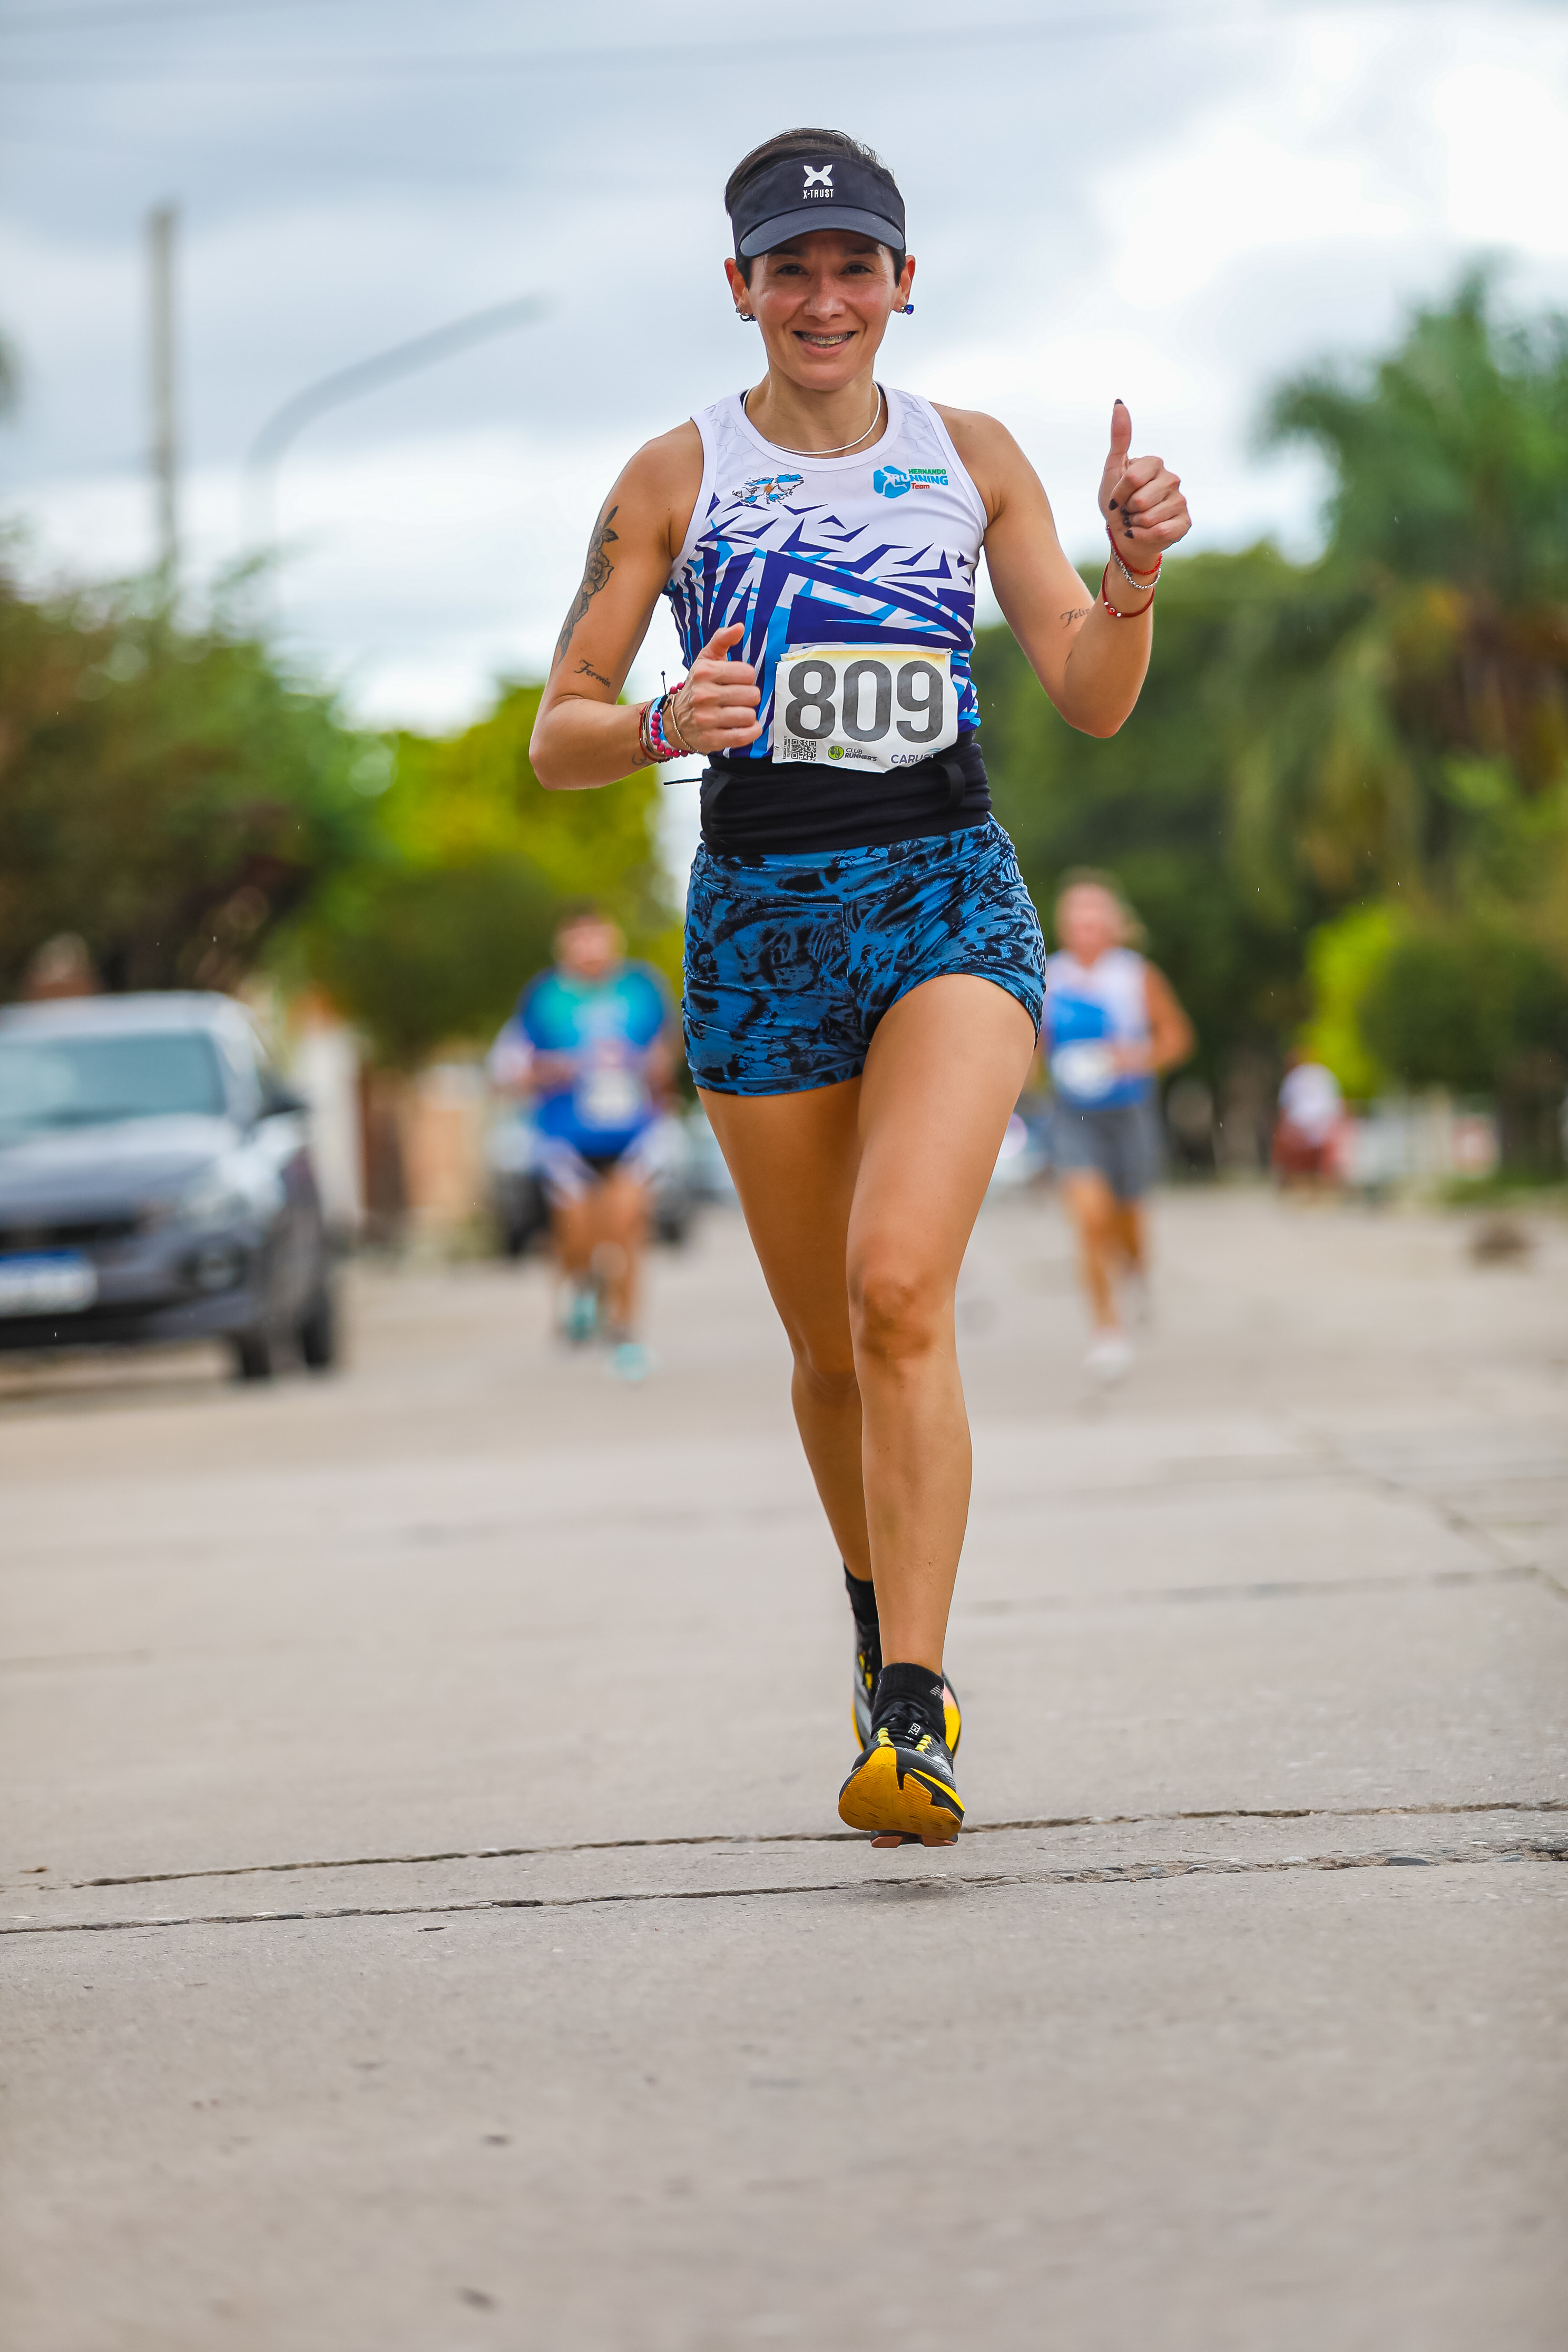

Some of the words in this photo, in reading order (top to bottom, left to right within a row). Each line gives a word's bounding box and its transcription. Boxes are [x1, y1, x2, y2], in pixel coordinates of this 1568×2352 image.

[803, 189, 834, 200] X-TRUST
[785, 660, 943, 743] 809
[844, 753, 877, 761] RUNNER'S
